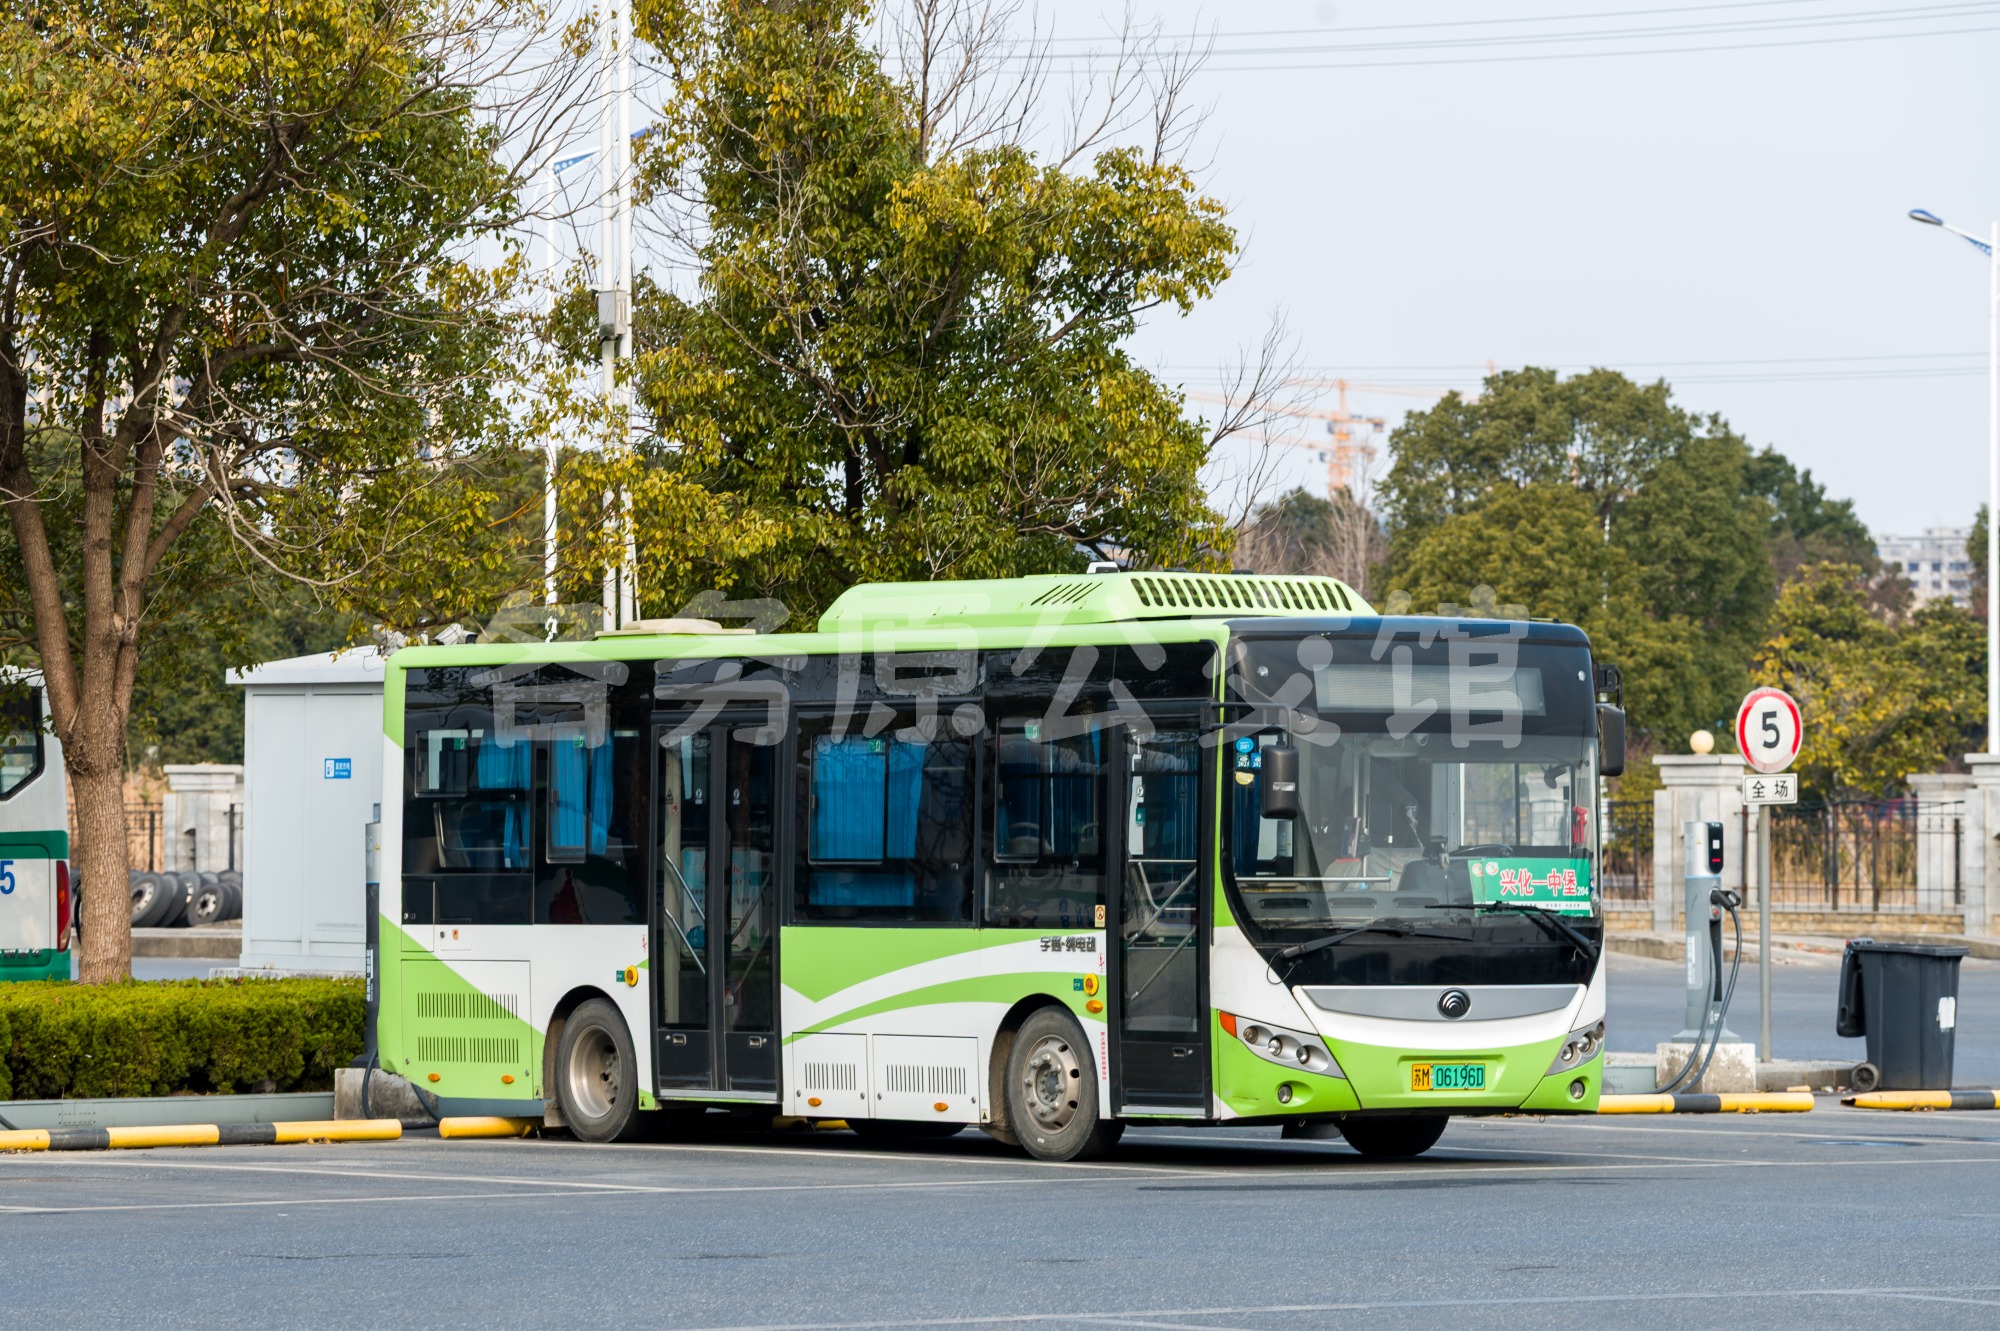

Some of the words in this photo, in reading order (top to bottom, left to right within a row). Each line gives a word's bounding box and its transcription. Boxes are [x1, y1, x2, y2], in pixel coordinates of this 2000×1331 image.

[1762, 711, 1780, 749] 5
[1752, 780, 1788, 798] 全场
[1577, 886, 1589, 896] 204
